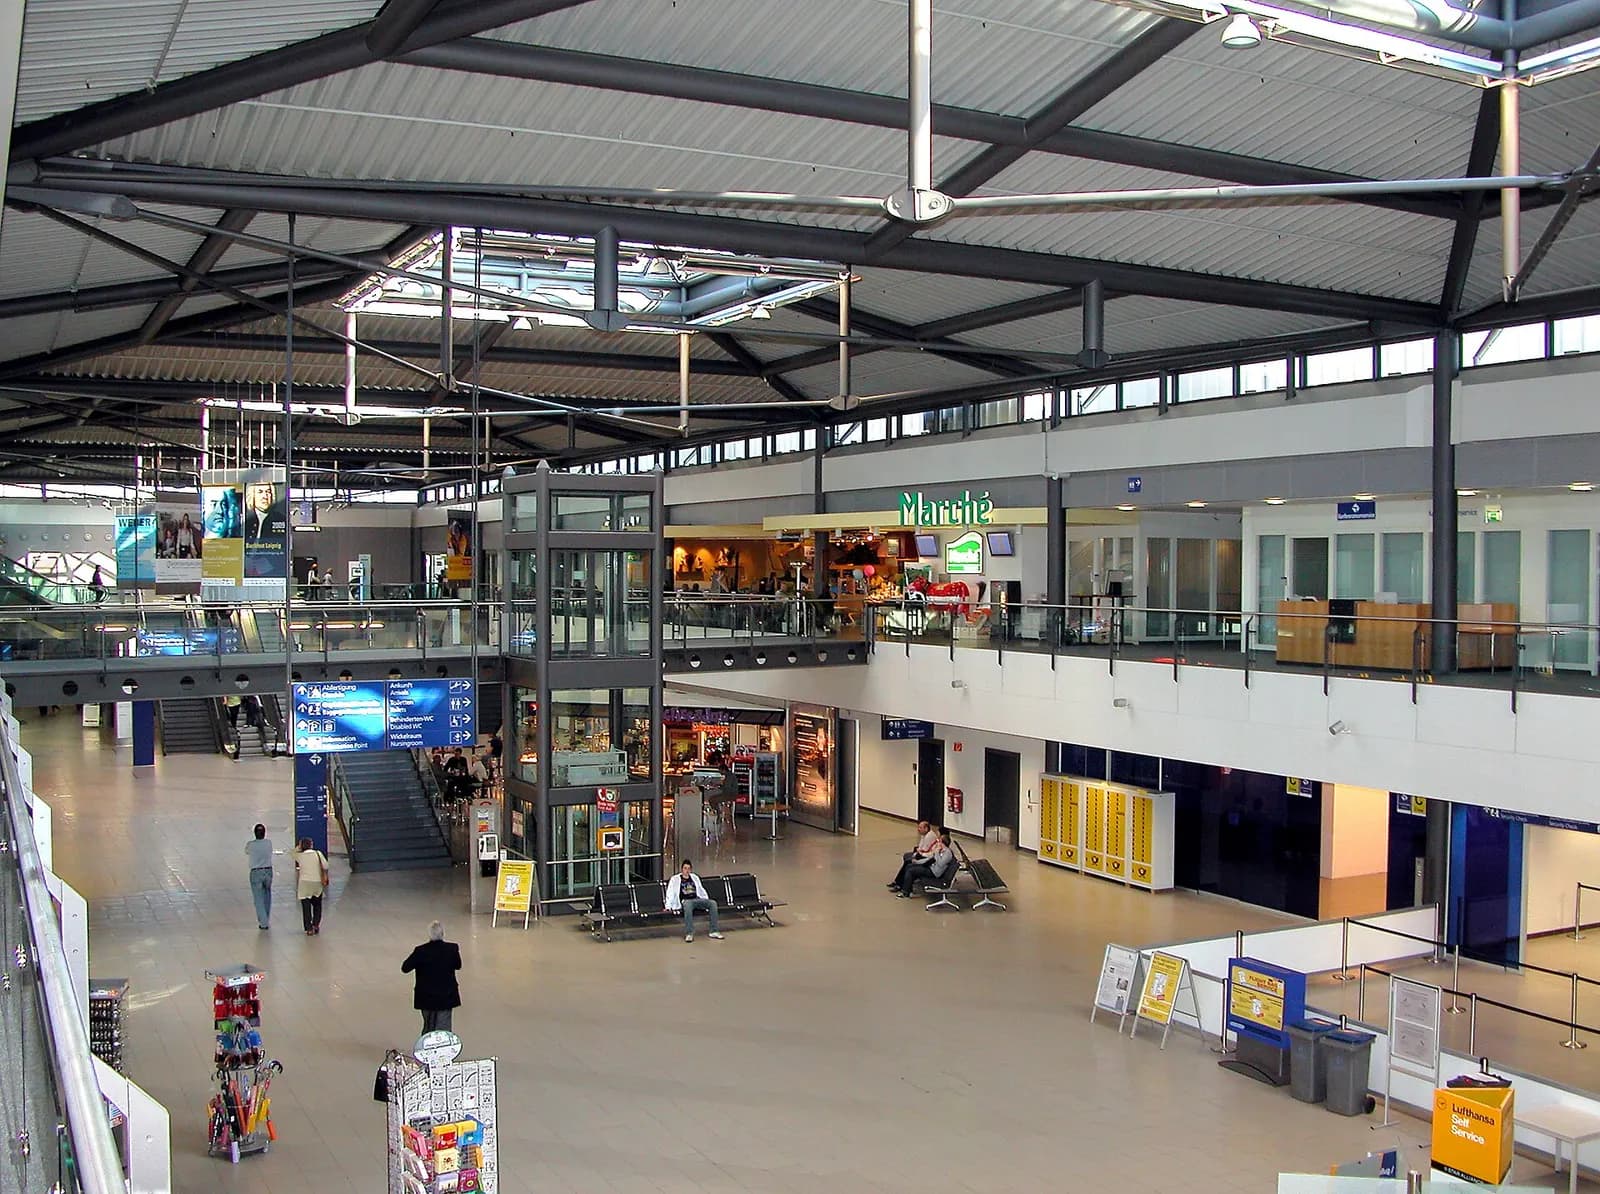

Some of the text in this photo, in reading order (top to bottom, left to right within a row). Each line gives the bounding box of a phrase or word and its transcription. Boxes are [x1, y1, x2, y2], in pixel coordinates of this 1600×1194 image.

[898, 489, 993, 526] Marché
[322, 683, 357, 693] Abfertigung
[390, 682, 413, 690] Ankunft
[390, 740, 424, 748] Nursingroom
[1451, 1113, 1470, 1128] Self
[1452, 1103, 1495, 1126] Lufthansa
[1451, 1125, 1485, 1144] Service
